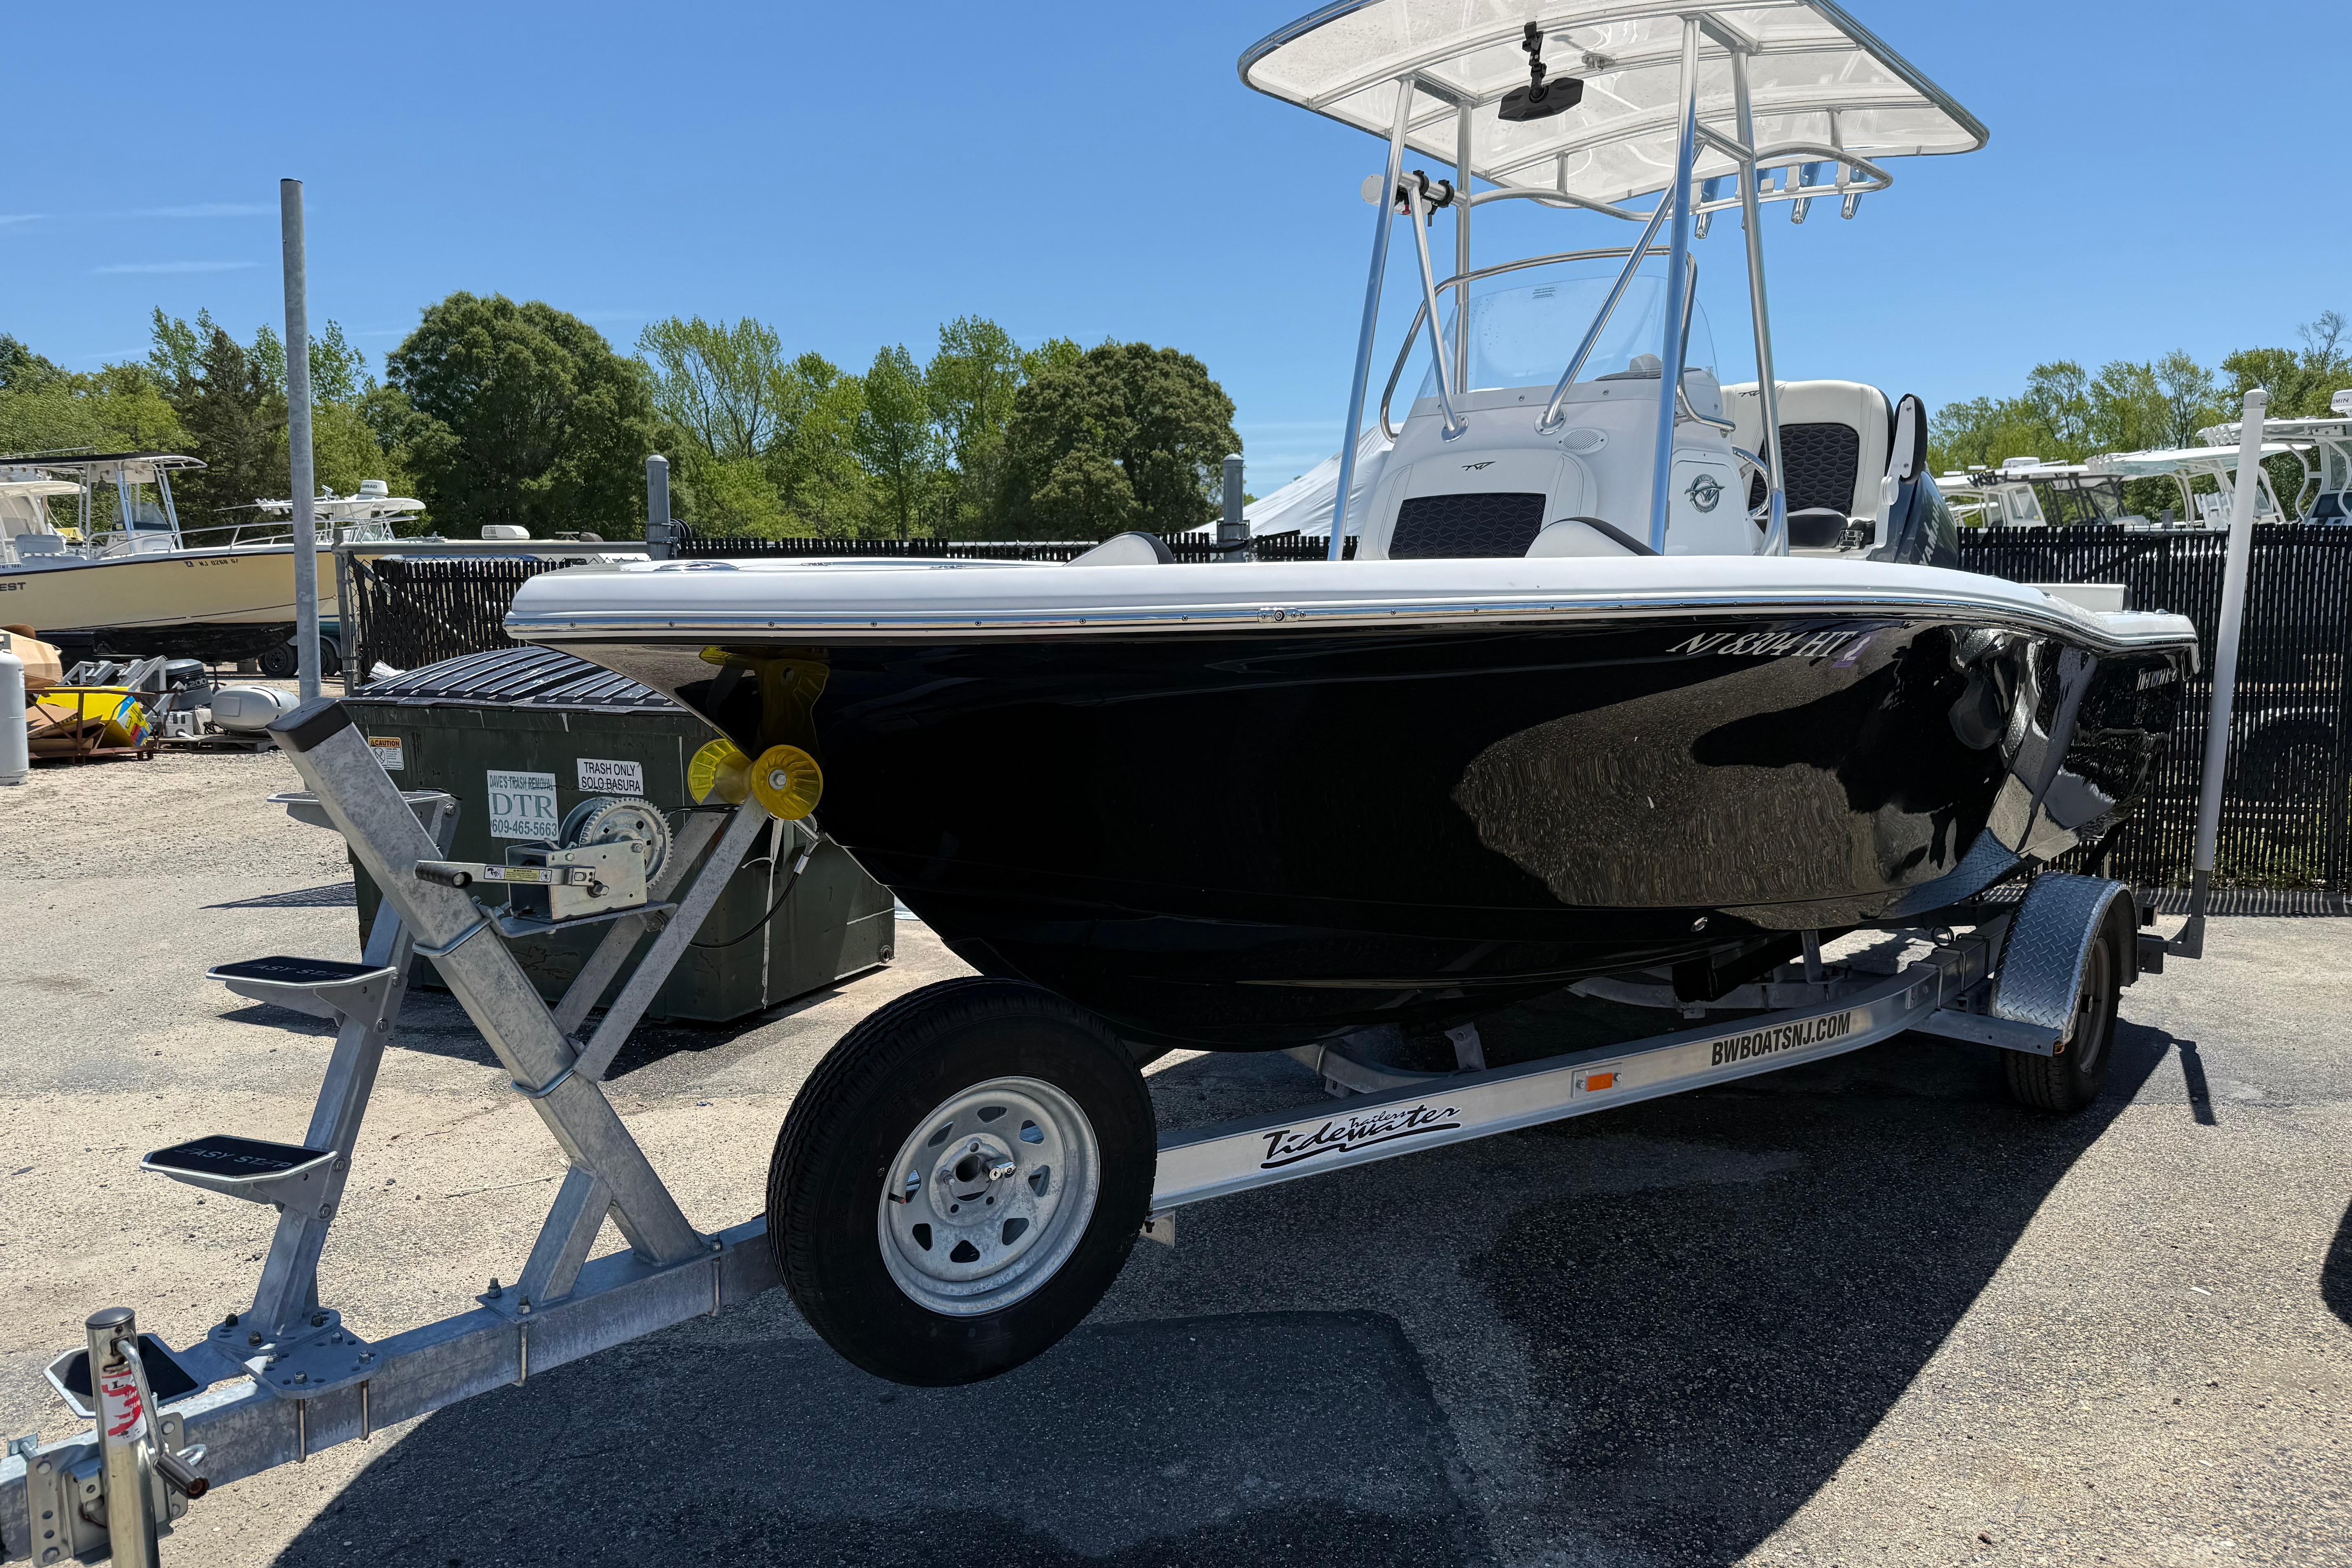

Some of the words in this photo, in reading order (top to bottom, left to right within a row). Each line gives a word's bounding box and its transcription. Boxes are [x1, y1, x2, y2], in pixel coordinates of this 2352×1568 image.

[0, 582, 26, 591] EST
[1666, 632, 1736, 656] NJ
[1717, 631, 1809, 656] 8304
[189, 677, 207, 688] 200
[584, 762, 612, 775] TRASH
[614, 764, 635, 777] ONLY
[490, 775, 508, 789] DAVE'S
[509, 776, 527, 790] TRASH
[528, 777, 554, 791] REMOVAL
[581, 776, 604, 789] SOLO
[607, 778, 641, 792] BASURA
[490, 793, 556, 819] DTR
[492, 819, 557, 837] 609-465-5663
[238, 964, 296, 972] EASY
[296, 969, 353, 978] STEP
[1712, 1011, 1851, 1066] BWBOATSNJ.COM
[1349, 1111, 1407, 1129] Trailers
[1262, 1104, 1461, 1160] Tidewater
[173, 1148, 236, 1159] EASY
[233, 1156, 293, 1168] STEP
